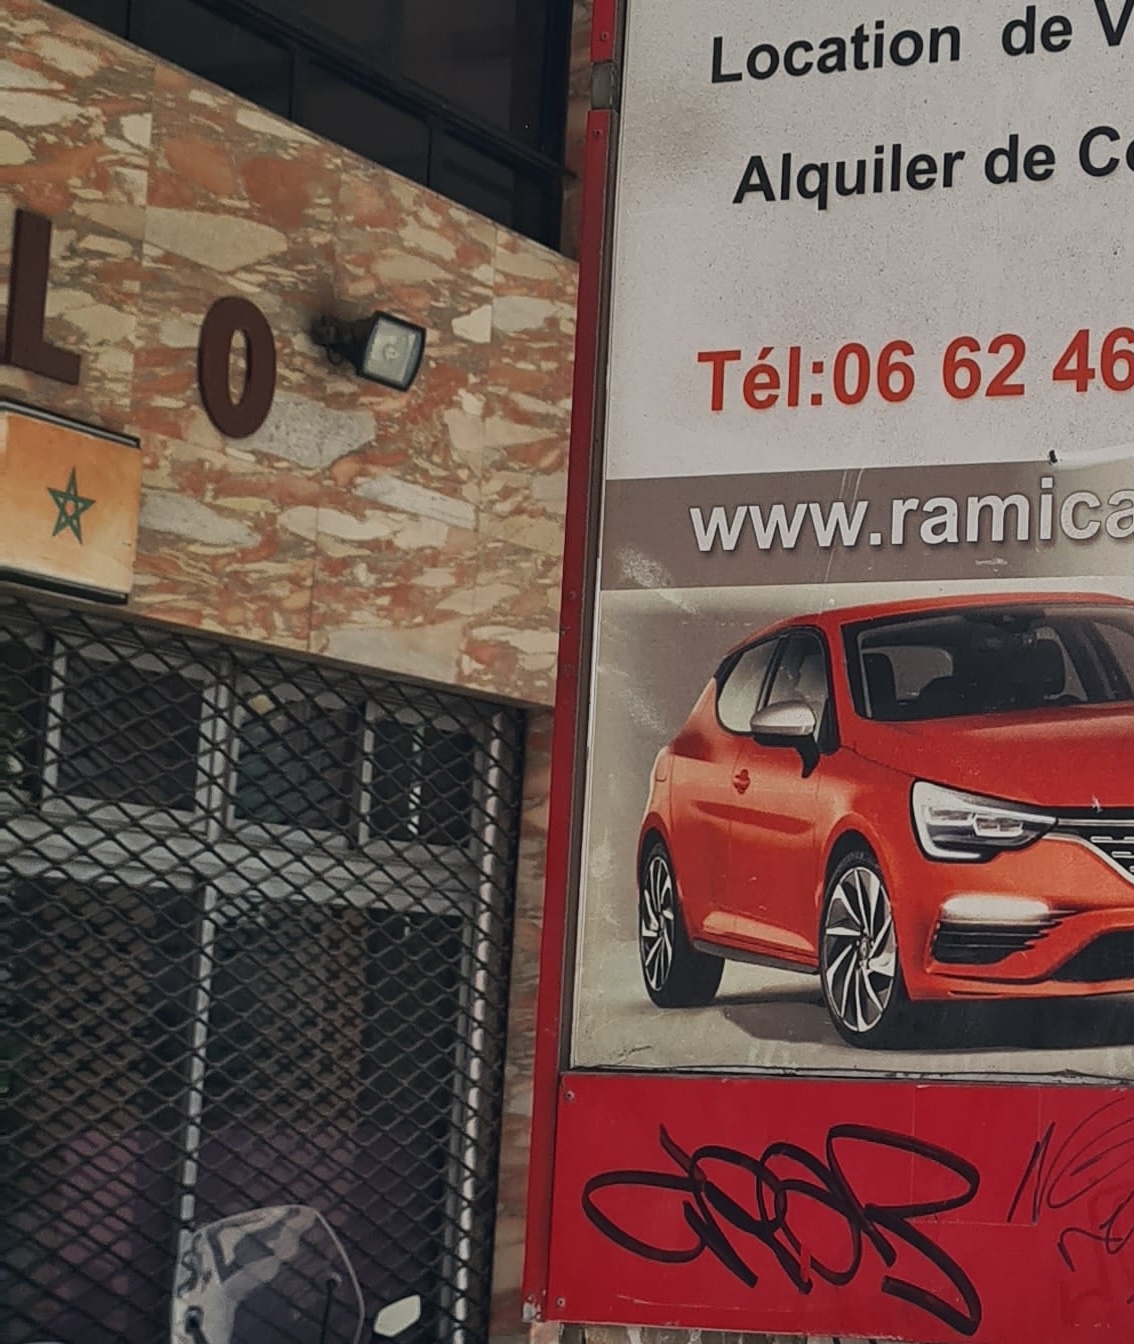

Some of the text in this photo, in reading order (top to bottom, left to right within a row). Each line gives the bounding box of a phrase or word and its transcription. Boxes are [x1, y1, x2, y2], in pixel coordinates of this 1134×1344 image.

[711, 19, 962, 83] Location
[1002, 6, 1073, 56] de
[733, 142, 965, 211] Alquiler
[984, 133, 1056, 184] de
[697, 339, 916, 412] Tél:06
[941, 332, 1026, 400] 62
